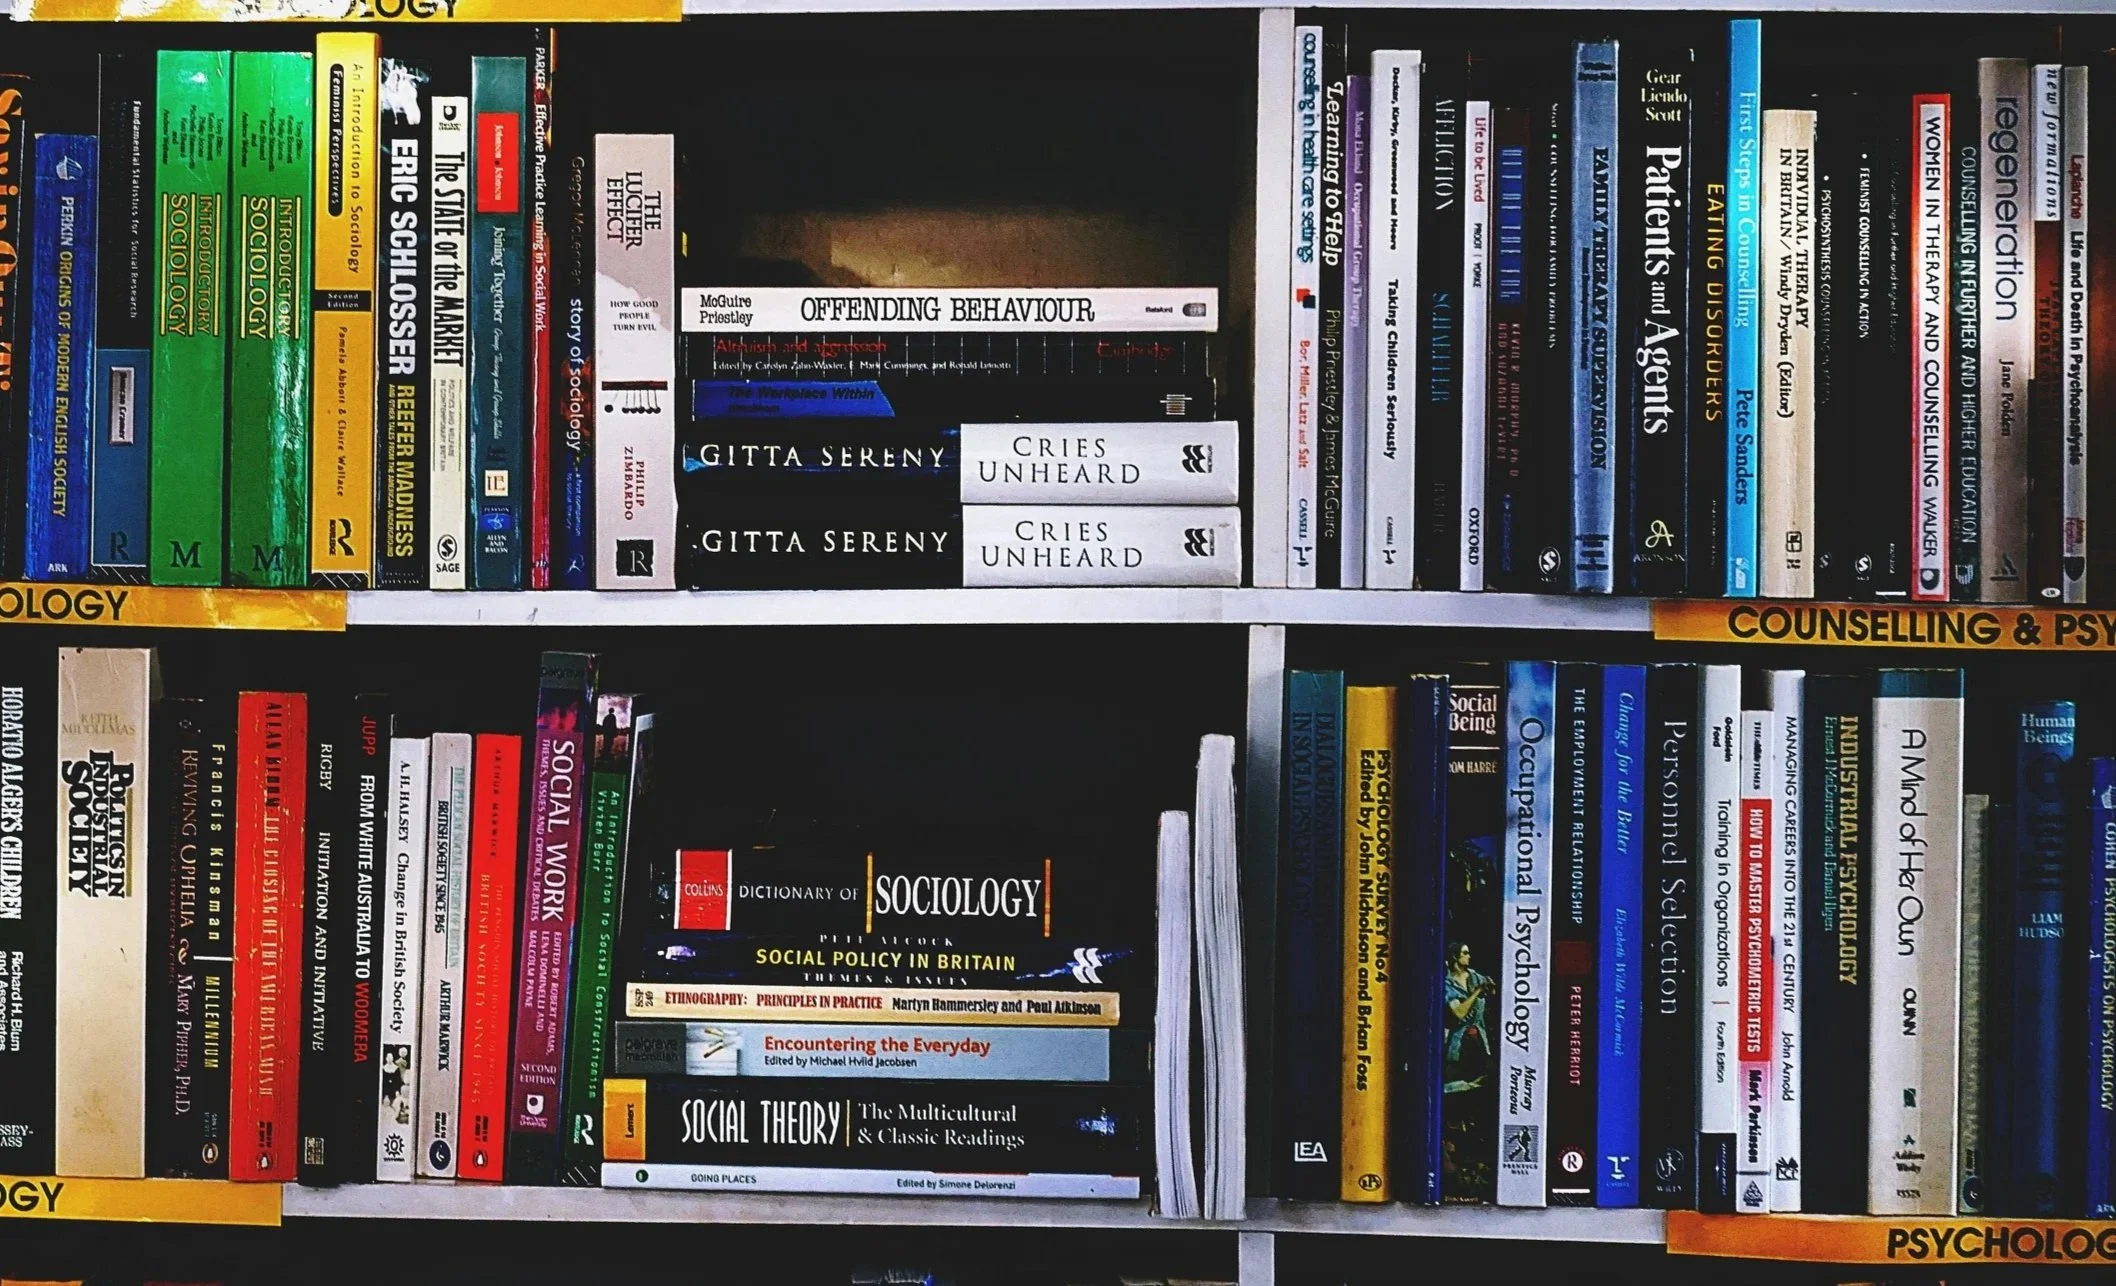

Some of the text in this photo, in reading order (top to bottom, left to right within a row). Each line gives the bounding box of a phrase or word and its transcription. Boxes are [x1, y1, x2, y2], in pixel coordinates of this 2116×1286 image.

[330, 69, 343, 205] Feminist Perspectives
[347, 63, 365, 274] An Introduction to Sociology
[1322, 81, 1345, 268] Learning to Help
[1474, 117, 1487, 204] Life to be Lived
[533, 47, 546, 332] PARKER Effective Practice Learning in Social Work
[606, 177, 625, 244] EFFECT
[625, 171, 643, 252] LUCIFER
[644, 191, 662, 231] THE
[1795, 148, 1809, 328] INDIVIDUAL THERAPY
[1987, 97, 2024, 320] regeneration
[167, 194, 188, 336] SOCIOLOGY
[197, 195, 213, 335] INTRODUCTORY
[249, 197, 269, 340] SOCIOLOGY
[388, 139, 418, 376] ERIC SCHLOSSER
[432, 152, 465, 368] The STATE or the MARKET
[1636, 145, 1683, 435] Patients and Agents
[1705, 183, 1725, 422] EATING DISORDERS
[1734, 92, 1758, 506] First Steps in Counselling Pete Sanders
[53, 196, 75, 518] PERKIN ORIGINS OF MODERN ENGLISH SOCIETY
[801, 296, 1096, 321] OFFENDING BEHAVIOUR
[1923, 116, 1941, 559] WOMEN IN THERAPY AND COUNSELLING WALKER
[566, 299, 585, 451] story of sociology
[1382, 280, 1399, 461] Taking Children Seriously
[395, 384, 416, 457] REEFER
[700, 444, 945, 468] GITTA SERENY
[1013, 435, 1106, 458] CRIES
[394, 461, 415, 558] MADNESS
[623, 446, 635, 521] ZIMBARDO
[634, 461, 645, 508] PHILIP
[977, 460, 1141, 485] UNHEARD
[48, 564, 68, 572] ARK
[436, 564, 461, 573] SAGE
[702, 529, 948, 553] GITTA SERENY
[980, 545, 1143, 568] UNHEARD
[1015, 520, 1108, 542] CRIES
[1468, 508, 1480, 566] OXFORD
[0, 587, 129, 621] OLOGY
[1729, 606, 2000, 646] COUNSELLING
[2012, 612, 2041, 646] &
[1448, 693, 1498, 712] Social
[62, 760, 93, 898] SOCIETY
[540, 739, 576, 924] SOCIAL WORK
[1660, 721, 1688, 1015] Personnel Selection
[1838, 715, 1860, 986] INDUSTRIAL PSYCHOLOGY
[203, 744, 226, 1069] Francis Kinsman MILLENNIUM
[353, 716, 376, 1064] JUPP FROM WHITE AUSTRALIA TO WOOMERA
[684, 874, 1042, 918] COLLINS DICTIONARY OF SOCIOLOGY
[1356, 749, 1375, 1092] Edited by John Nicholson and Brian Foss
[1505, 717, 1546, 1053] Occupational Psychology
[1569, 688, 1586, 1087] THE EMPLOYMENT RELATIONSHIP PETER HERRIOT
[1897, 729, 1929, 1037] A Mind of Her Own QUINN
[10, 951, 24, 1052] Richard H. Blum
[756, 948, 1016, 972] SOCIAL POLICY IN BRITAIN
[764, 1035, 992, 1058] Encountering the Everyday
[682, 1098, 842, 1145] SOCIAL THEORY
[0, 1180, 64, 1213] GY
[691, 1174, 757, 1185] GOING PLACES
[896, 1177, 1016, 1191] Edited by Simone Delorenzi
[1887, 1226, 2116, 1261] PSYCHOLOG
